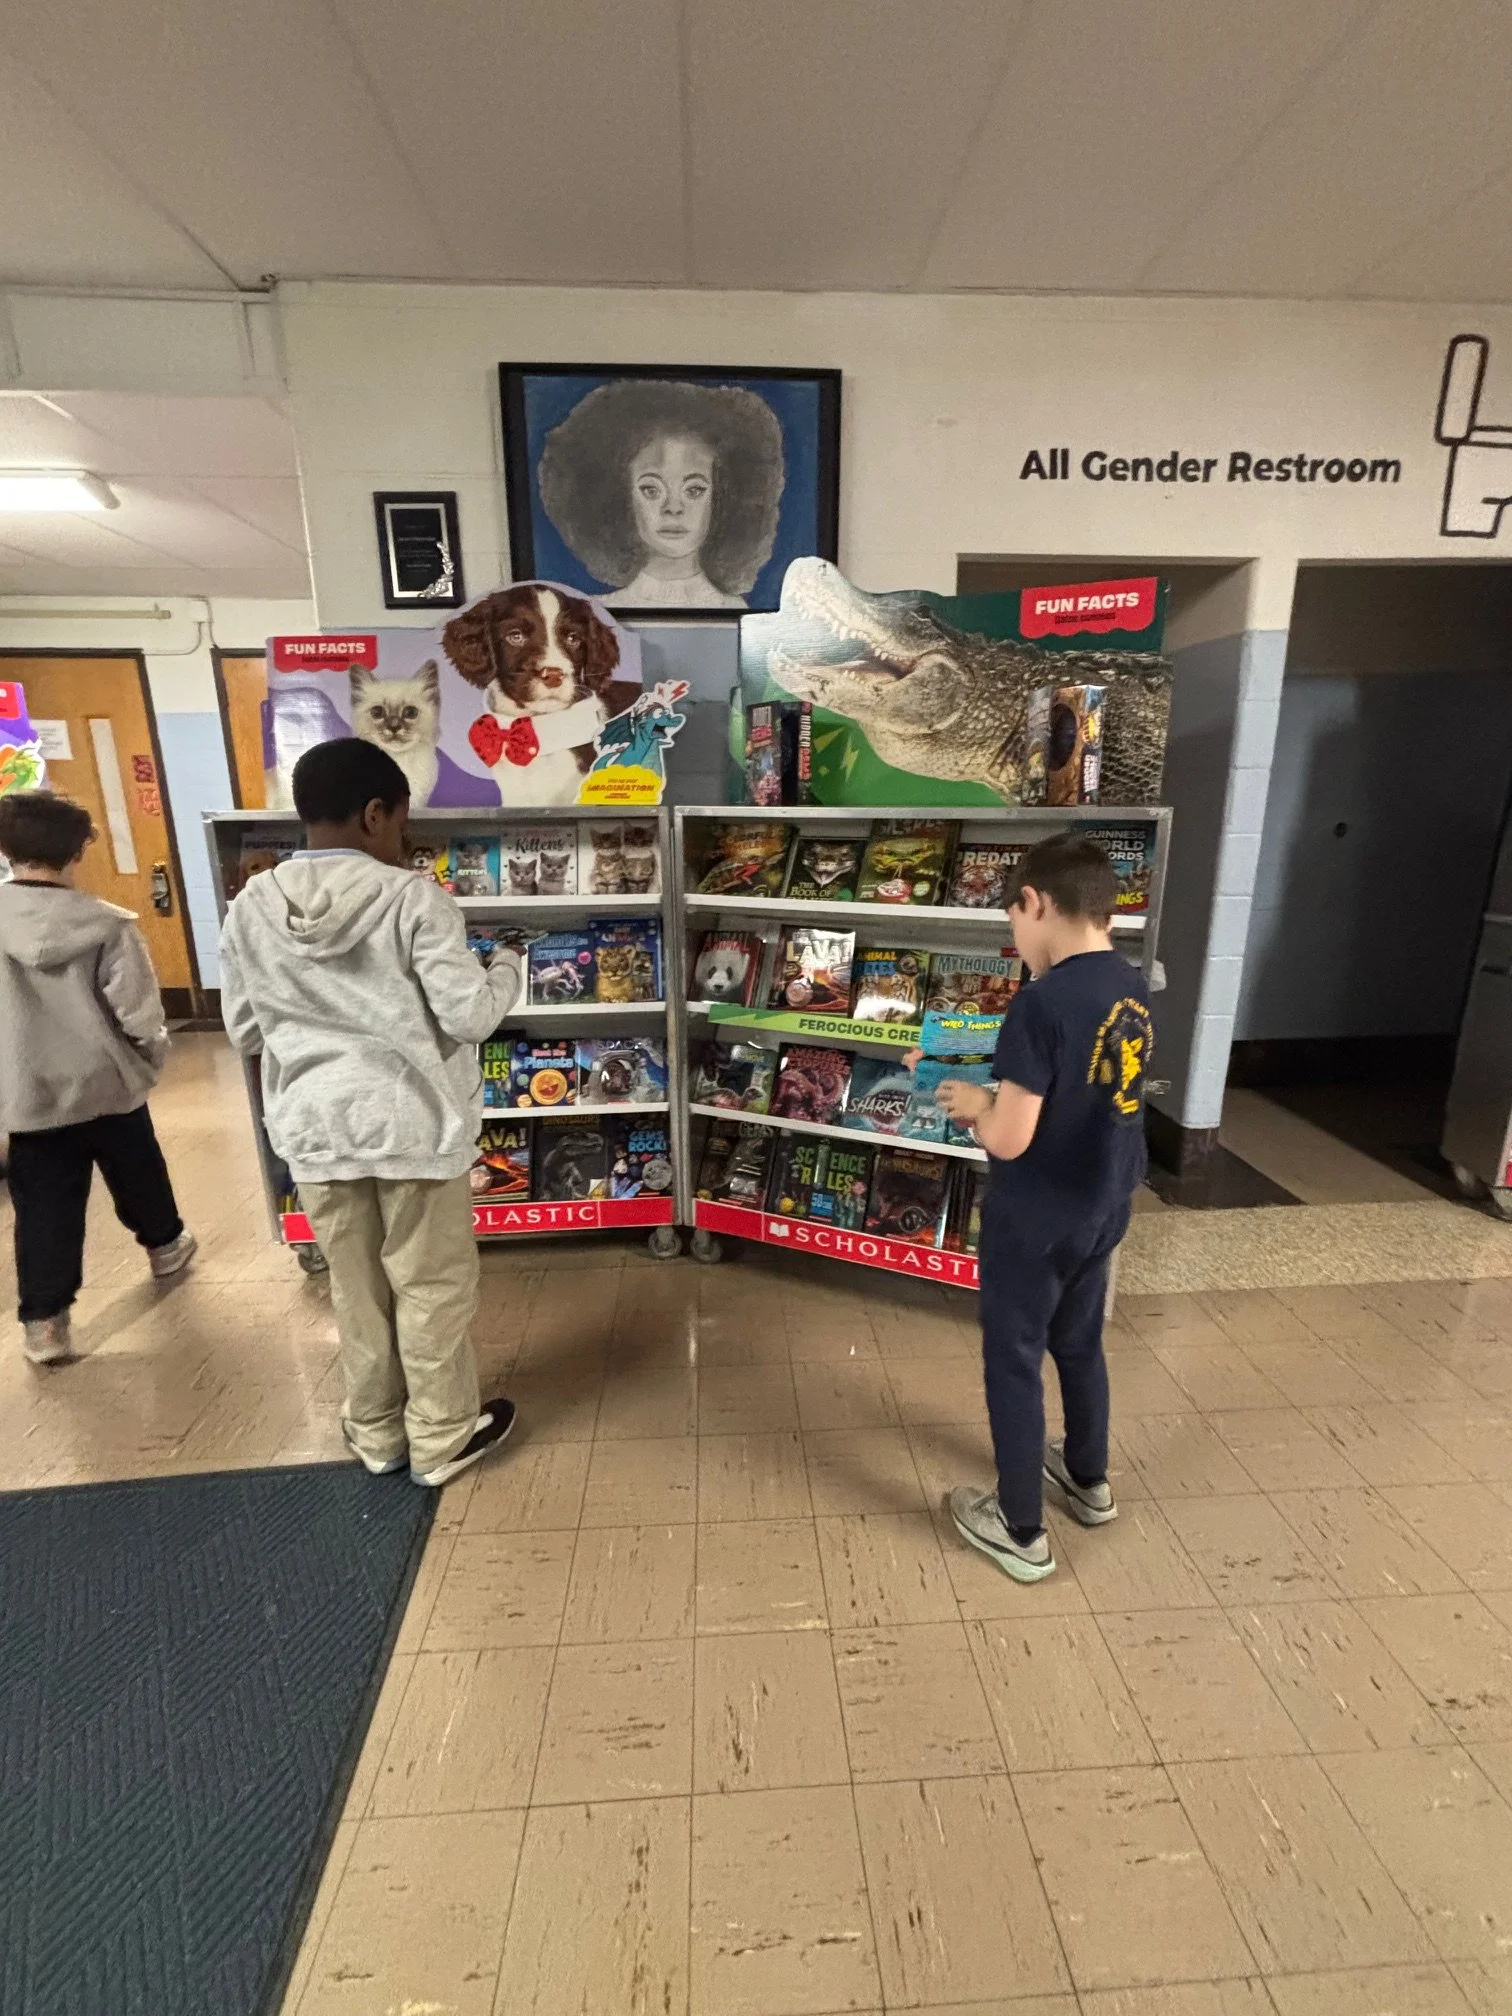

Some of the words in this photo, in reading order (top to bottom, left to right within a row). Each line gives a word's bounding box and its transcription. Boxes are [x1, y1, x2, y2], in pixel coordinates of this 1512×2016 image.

[1019, 448, 1069, 480] All
[1081, 451, 1217, 482] Gender
[1227, 451, 1401, 482] Restroom
[1035, 598, 1074, 615] FUN
[1077, 591, 1139, 611] FACTS
[284, 643, 316, 655] FUN
[318, 642, 366, 654] FACTS
[1085, 829, 1146, 839] GUINNESS
[1102, 840, 1144, 851] ORLD
[962, 851, 1021, 866] REDAT
[1108, 851, 1144, 860] ORDS
[790, 886, 817, 897] BOOK
[819, 889, 832, 898] OF
[938, 956, 1013, 976] MYTHOLOGY
[798, 1018, 883, 1038] FEROCIOUS
[887, 1028, 919, 1042] CRE
[967, 1020, 1002, 1031] THINGS
[483, 1061, 510, 1079] LES
[523, 1056, 574, 1069] Planets
[847, 1093, 912, 1117] SHARKS!
[478, 1127, 527, 1149] AVA!
[629, 1131, 664, 1141] GEMS
[628, 1140, 668, 1153] ROCK!
[472, 1206, 595, 1227] LASTIC
[796, 1227, 979, 1280] SCHOLASTI
